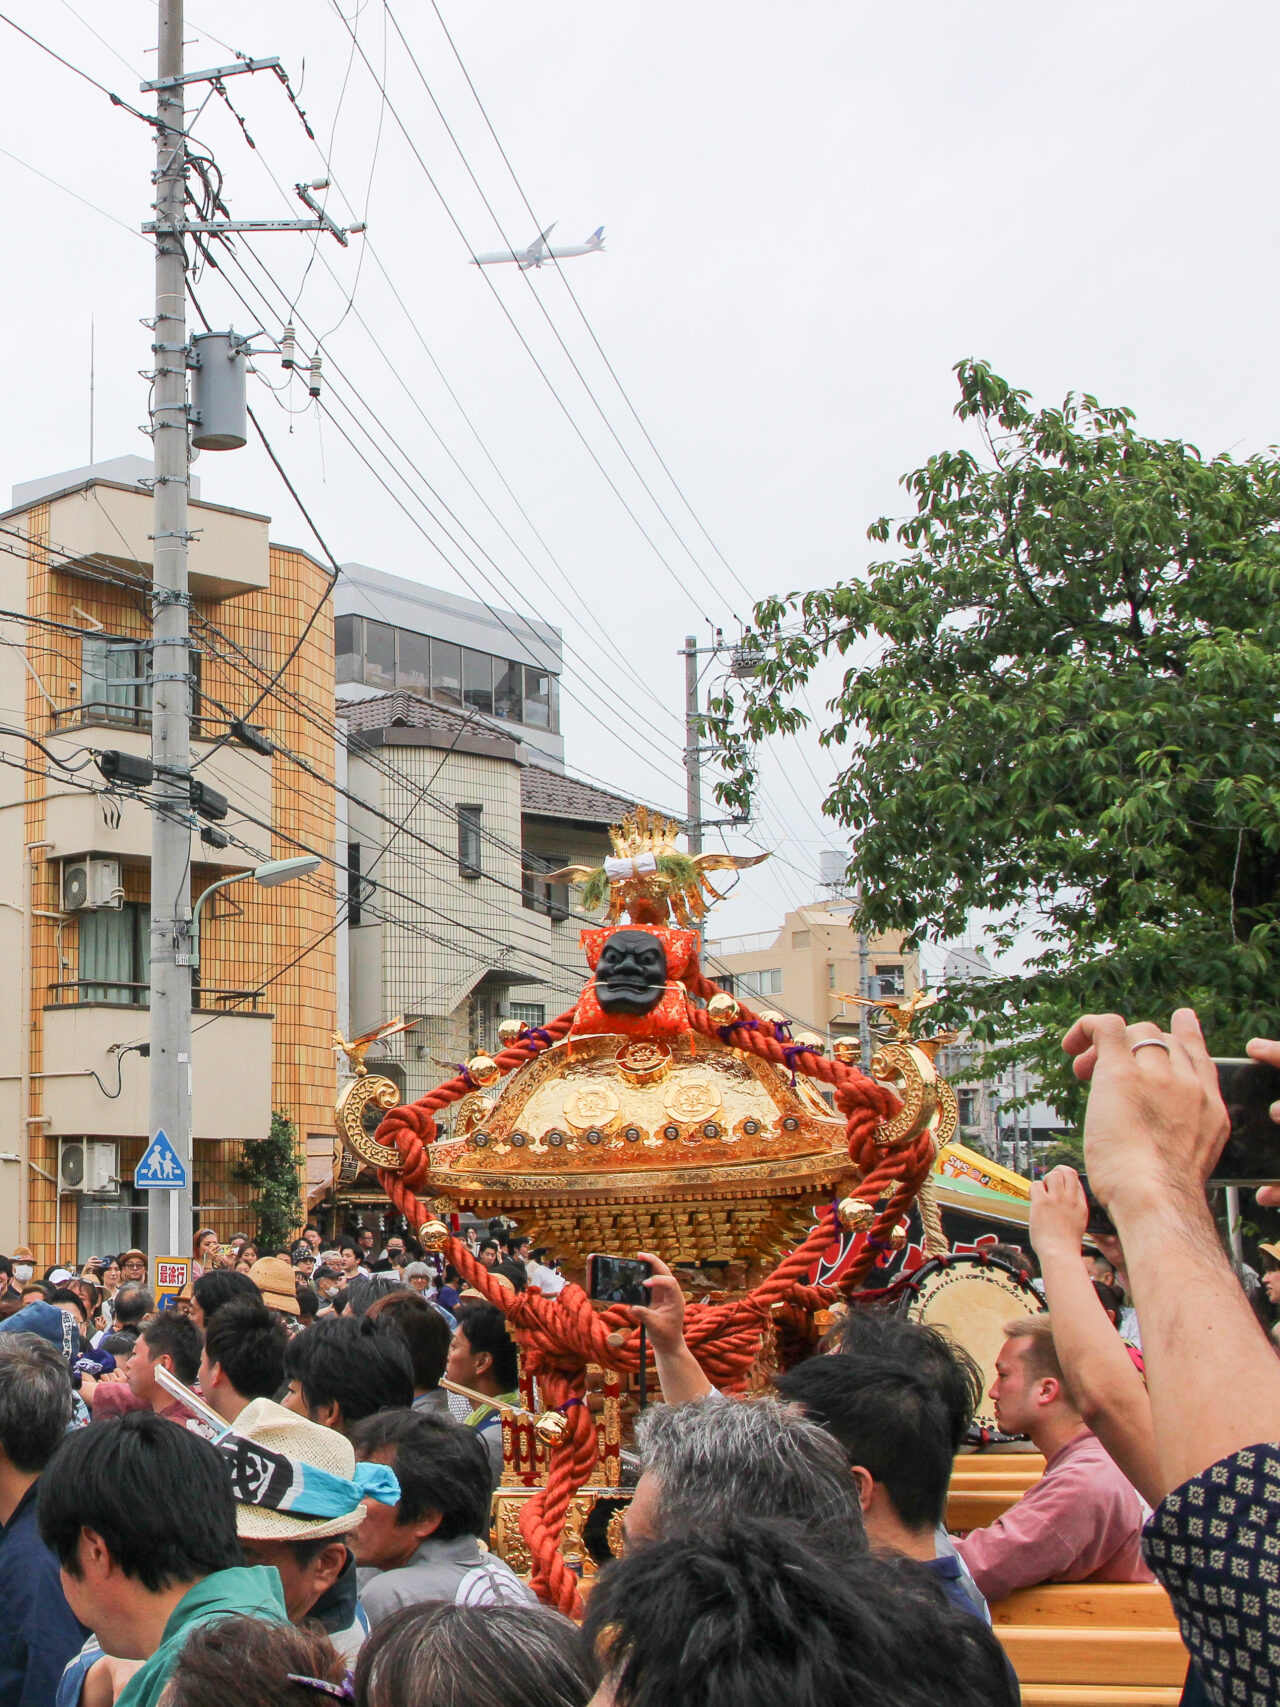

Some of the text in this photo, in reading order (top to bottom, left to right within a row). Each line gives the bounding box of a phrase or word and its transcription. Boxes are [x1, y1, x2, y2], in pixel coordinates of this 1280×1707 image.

[947, 1154, 970, 1174] SNS
[160, 1265, 185, 1284] 最徐行
